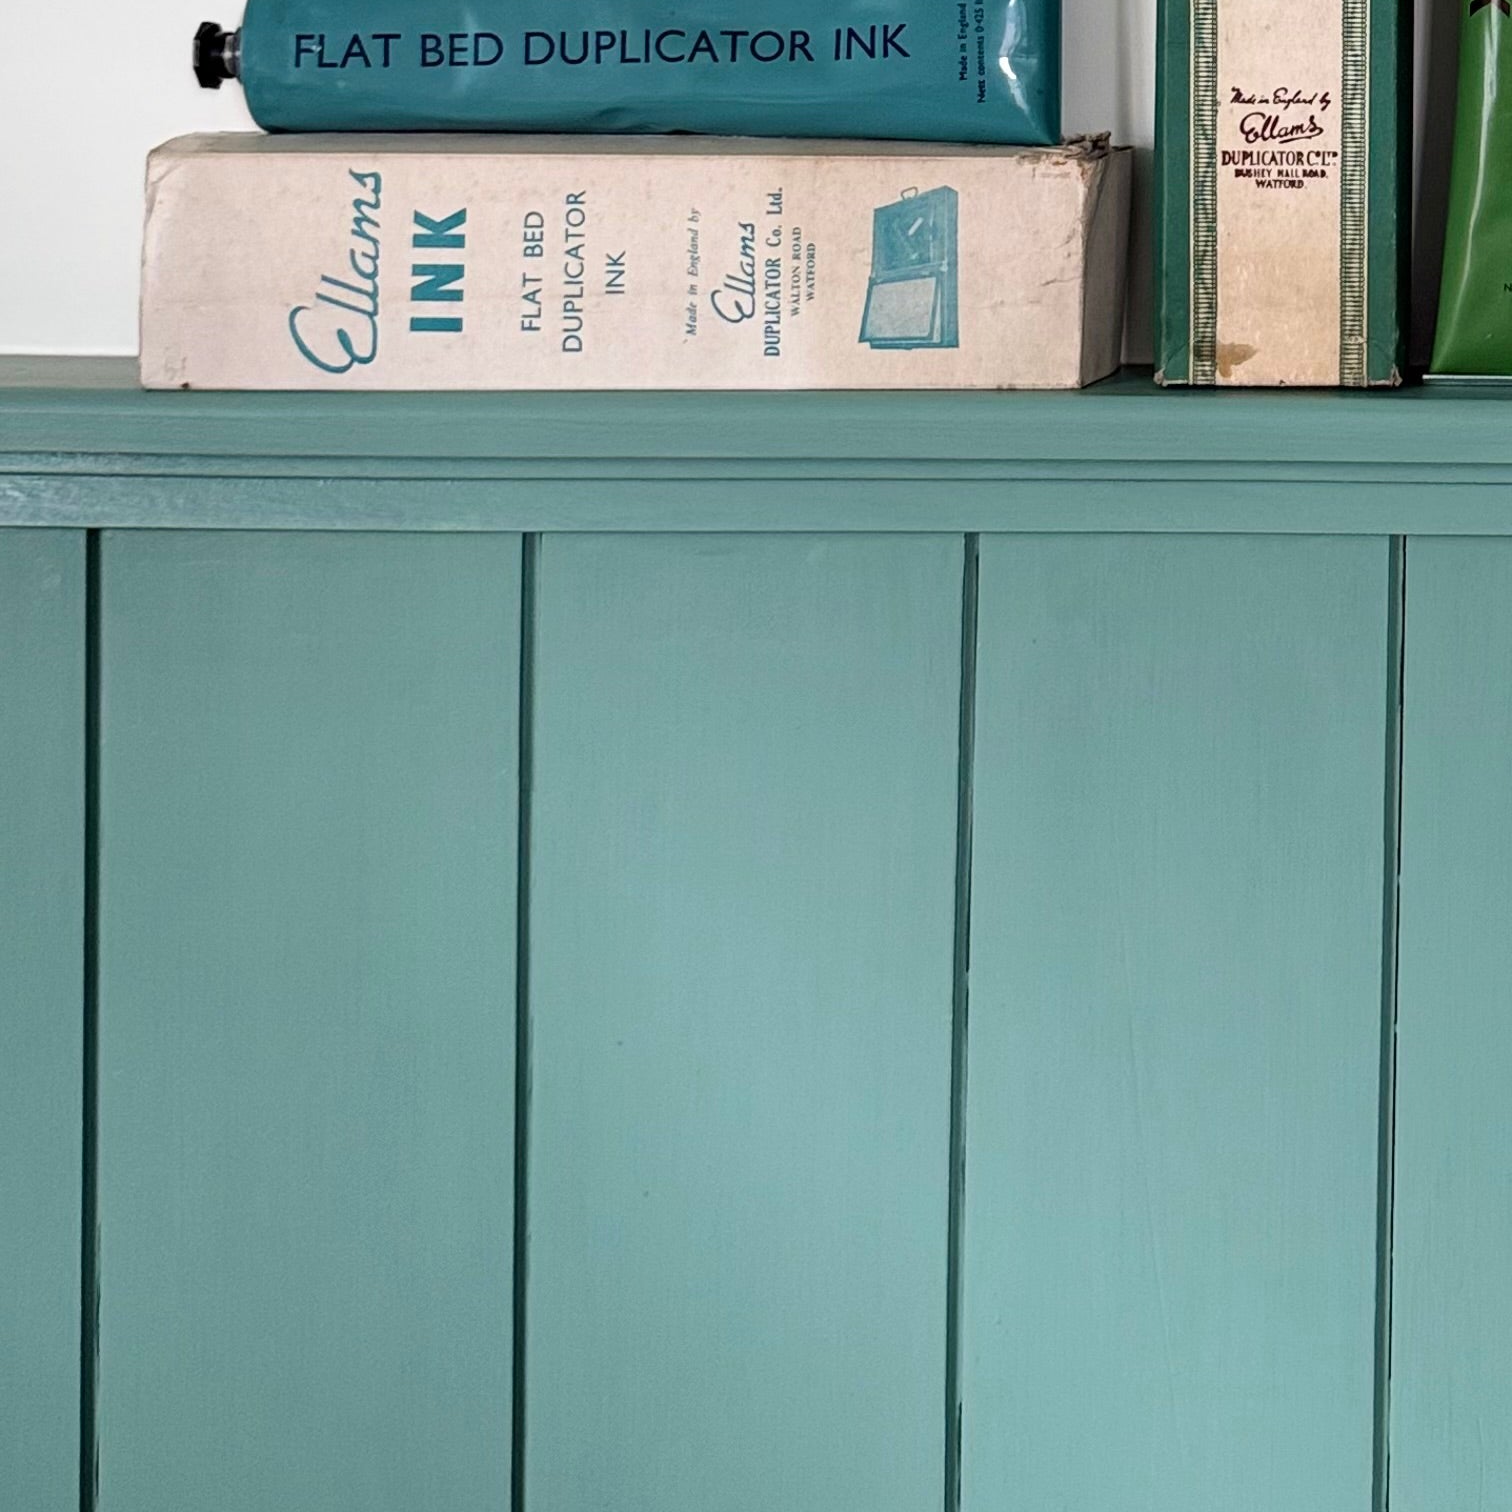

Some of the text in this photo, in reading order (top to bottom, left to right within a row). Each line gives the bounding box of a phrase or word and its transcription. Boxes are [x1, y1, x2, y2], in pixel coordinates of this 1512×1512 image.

[294, 23, 912, 69] FLAT BED DUPLICATOR INK
[957, 2, 969, 81] Made in England
[977, 35, 985, 76] contents
[977, 79, 986, 103] Nett
[1230, 86, 1332, 112] Made in England by
[1221, 149, 1305, 167] DUPLICATOR
[1239, 111, 1325, 145] Ellams
[1277, 168, 1301, 179] HALL
[289, 167, 382, 374] Ellams
[409, 207, 467, 332] INK
[520, 210, 546, 332] FLAT BED
[561, 190, 587, 354] DUPLICATOR
[605, 251, 627, 296] INK
[685, 207, 702, 336] Made in England by
[710, 221, 756, 324] Ellams
[763, 186, 784, 357] DUPLICATOR Co. Ltd.
[790, 226, 803, 318] WALTON ROAD
[805, 242, 817, 302] WATFORD
